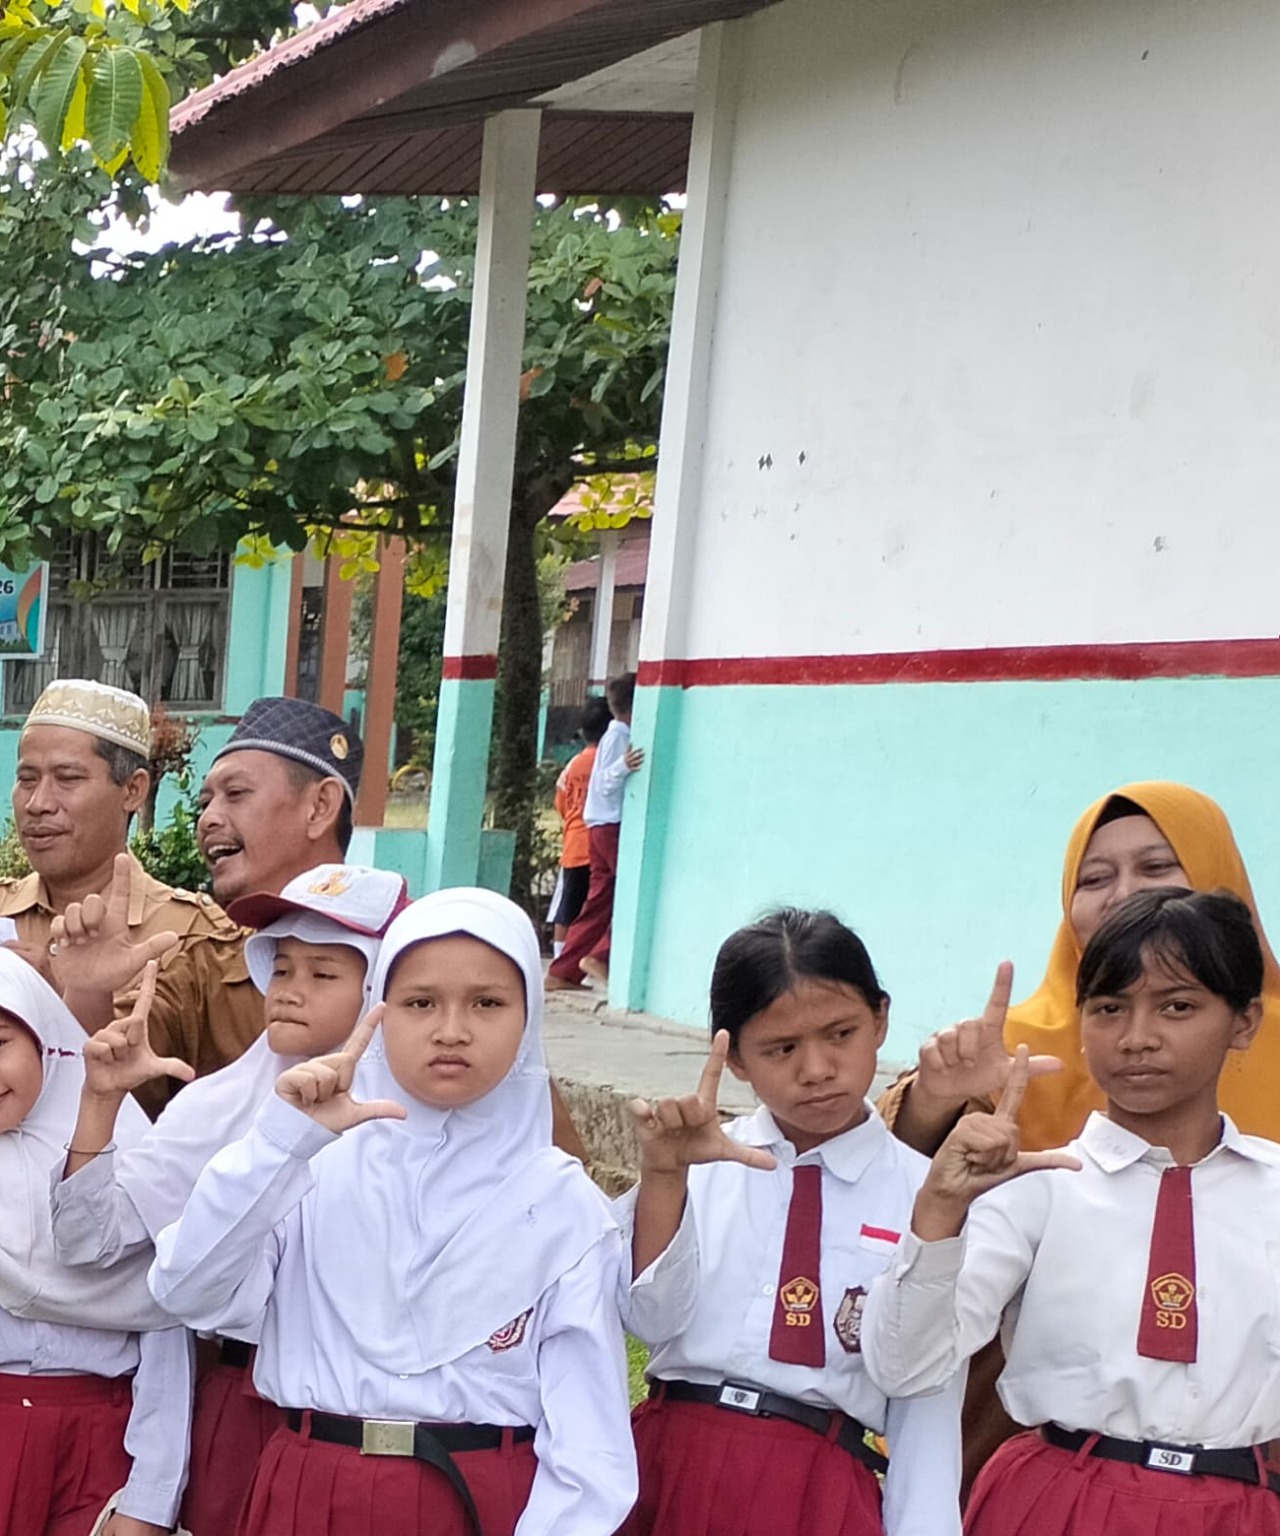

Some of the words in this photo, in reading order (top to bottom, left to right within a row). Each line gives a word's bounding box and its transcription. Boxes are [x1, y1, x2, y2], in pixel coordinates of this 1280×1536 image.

[784, 1312, 811, 1327] SD
[1155, 1311, 1187, 1329] SD
[1158, 1452, 1183, 1467] SD
